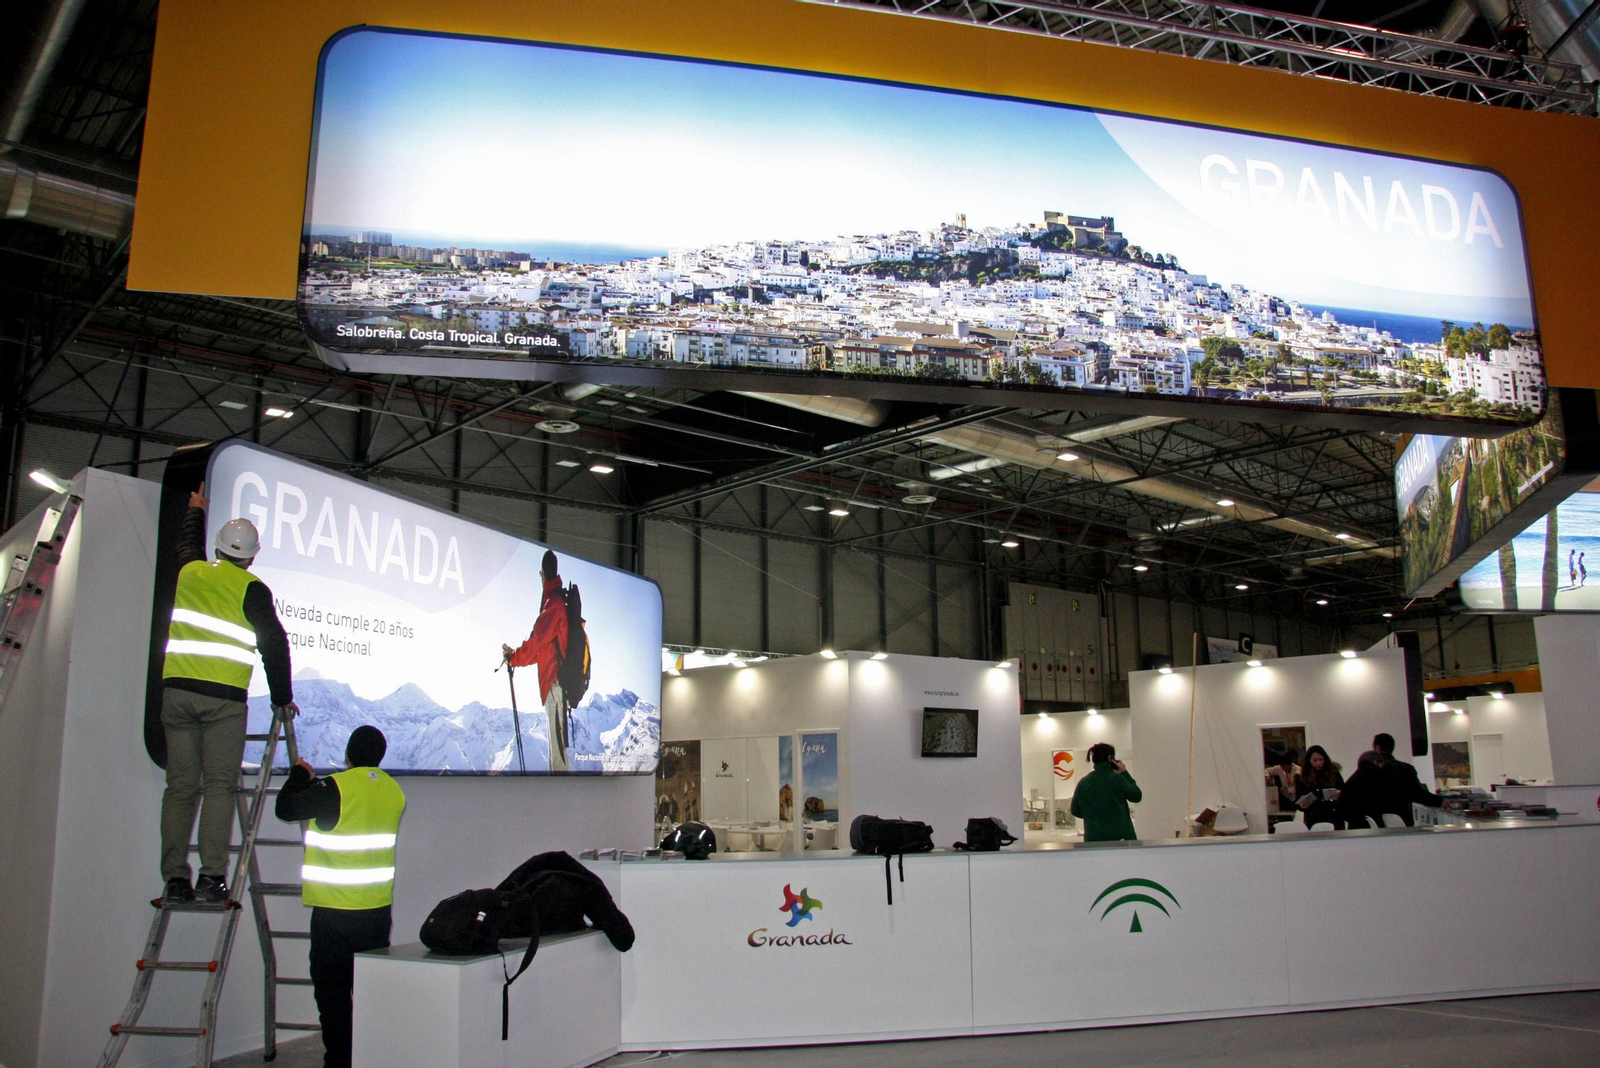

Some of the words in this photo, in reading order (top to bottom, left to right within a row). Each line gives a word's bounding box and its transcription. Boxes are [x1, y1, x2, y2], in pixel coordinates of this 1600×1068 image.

[1198, 153, 1504, 249] GRANADA
[336, 324, 406, 339] Salobreña.
[409, 328, 445, 341] Costa
[448, 329, 501, 345] Tropical.
[504, 332, 561, 347] Granada.
[1396, 434, 1429, 499] GRANADA
[231, 471, 465, 594] GRANADA
[275, 597, 322, 623] Nevada
[326, 612, 370, 633] cumple
[373, 618, 386, 634] 20
[389, 621, 414, 639] años
[286, 632, 315, 651] rque
[319, 632, 371, 656] Nacional
[1241, 637, 1251, 652] C
[747, 927, 853, 948] Granada
